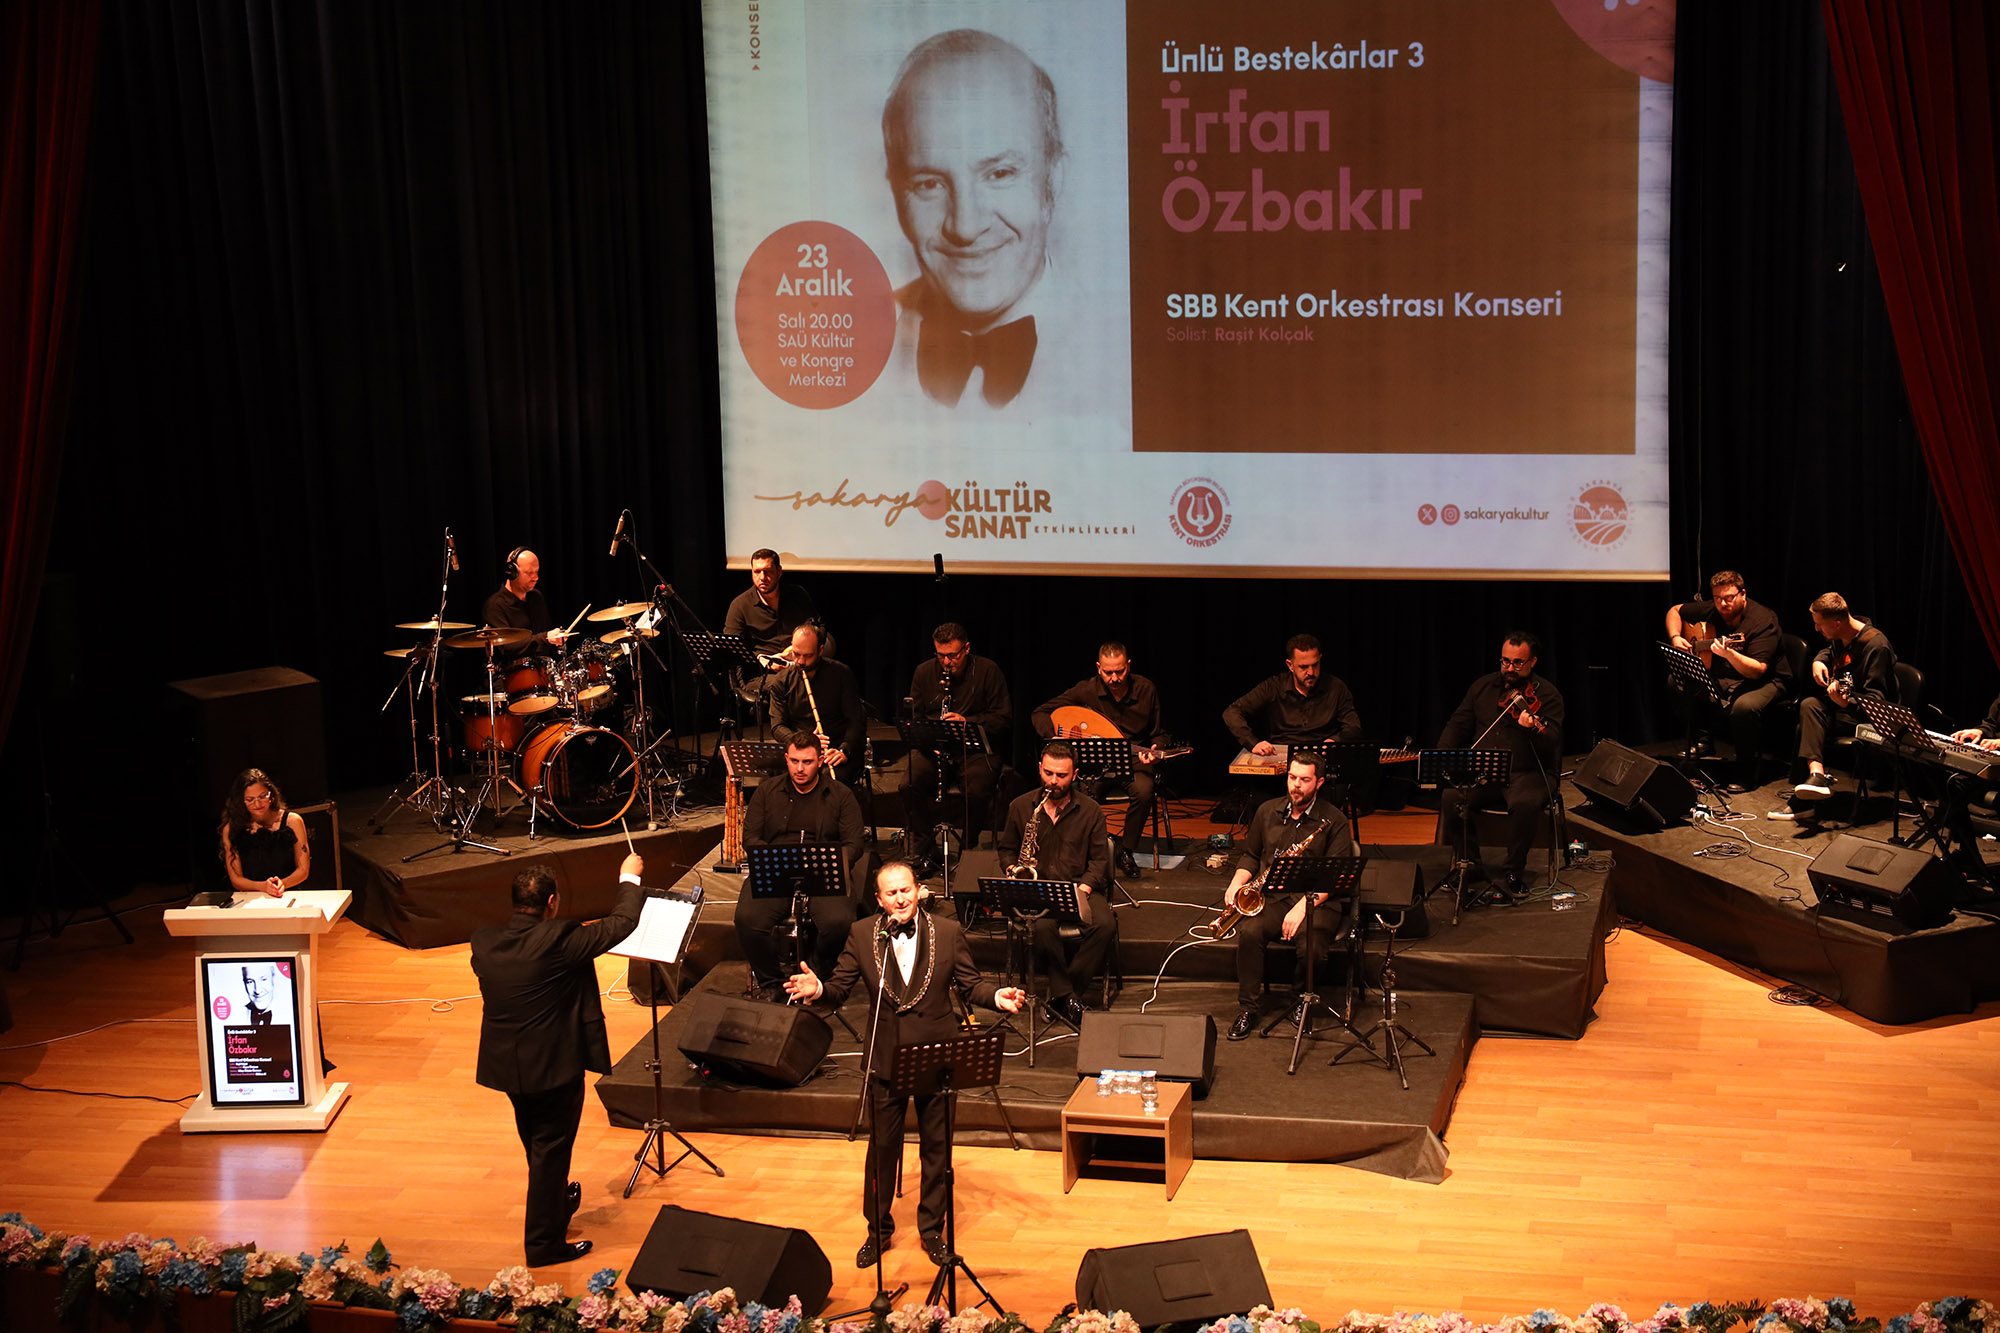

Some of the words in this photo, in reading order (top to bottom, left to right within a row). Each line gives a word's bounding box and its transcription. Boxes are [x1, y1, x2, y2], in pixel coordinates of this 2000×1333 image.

[748, 0, 761, 60] KONSE
[1161, 40, 1224, 73] Ünlü
[1233, 39, 1399, 72] Bestekârlar
[1407, 41, 1425, 68] 3
[1161, 79, 1331, 154] İrfan
[1161, 159, 1423, 233] Özbakır
[797, 243, 829, 268] 23
[775, 268, 854, 297] Aralık
[1166, 293, 1218, 319] SBB
[1224, 293, 1289, 318] Kent
[1295, 289, 1445, 318] Orkestrası
[1453, 289, 1563, 317] Konseri
[778, 312, 806, 329] Salı
[809, 313, 853, 329] 20.00
[1215, 326, 1255, 345] Raşit
[1258, 324, 1315, 345] Kolçak
[777, 330, 807, 349] SAÜ
[811, 331, 855, 349] Kültür
[779, 356, 797, 368] ve
[800, 353, 855, 372] Kongre
[788, 371, 847, 387] Merkezi
[753, 478, 942, 528] sakarya
[945, 480, 1053, 514] KÜLTÜR
[944, 514, 1032, 540] SANAT
[1463, 507, 1550, 524] sakaryakultur
[1168, 513, 1186, 540] KENT
[1185, 513, 1233, 548] ORKESTRASI
